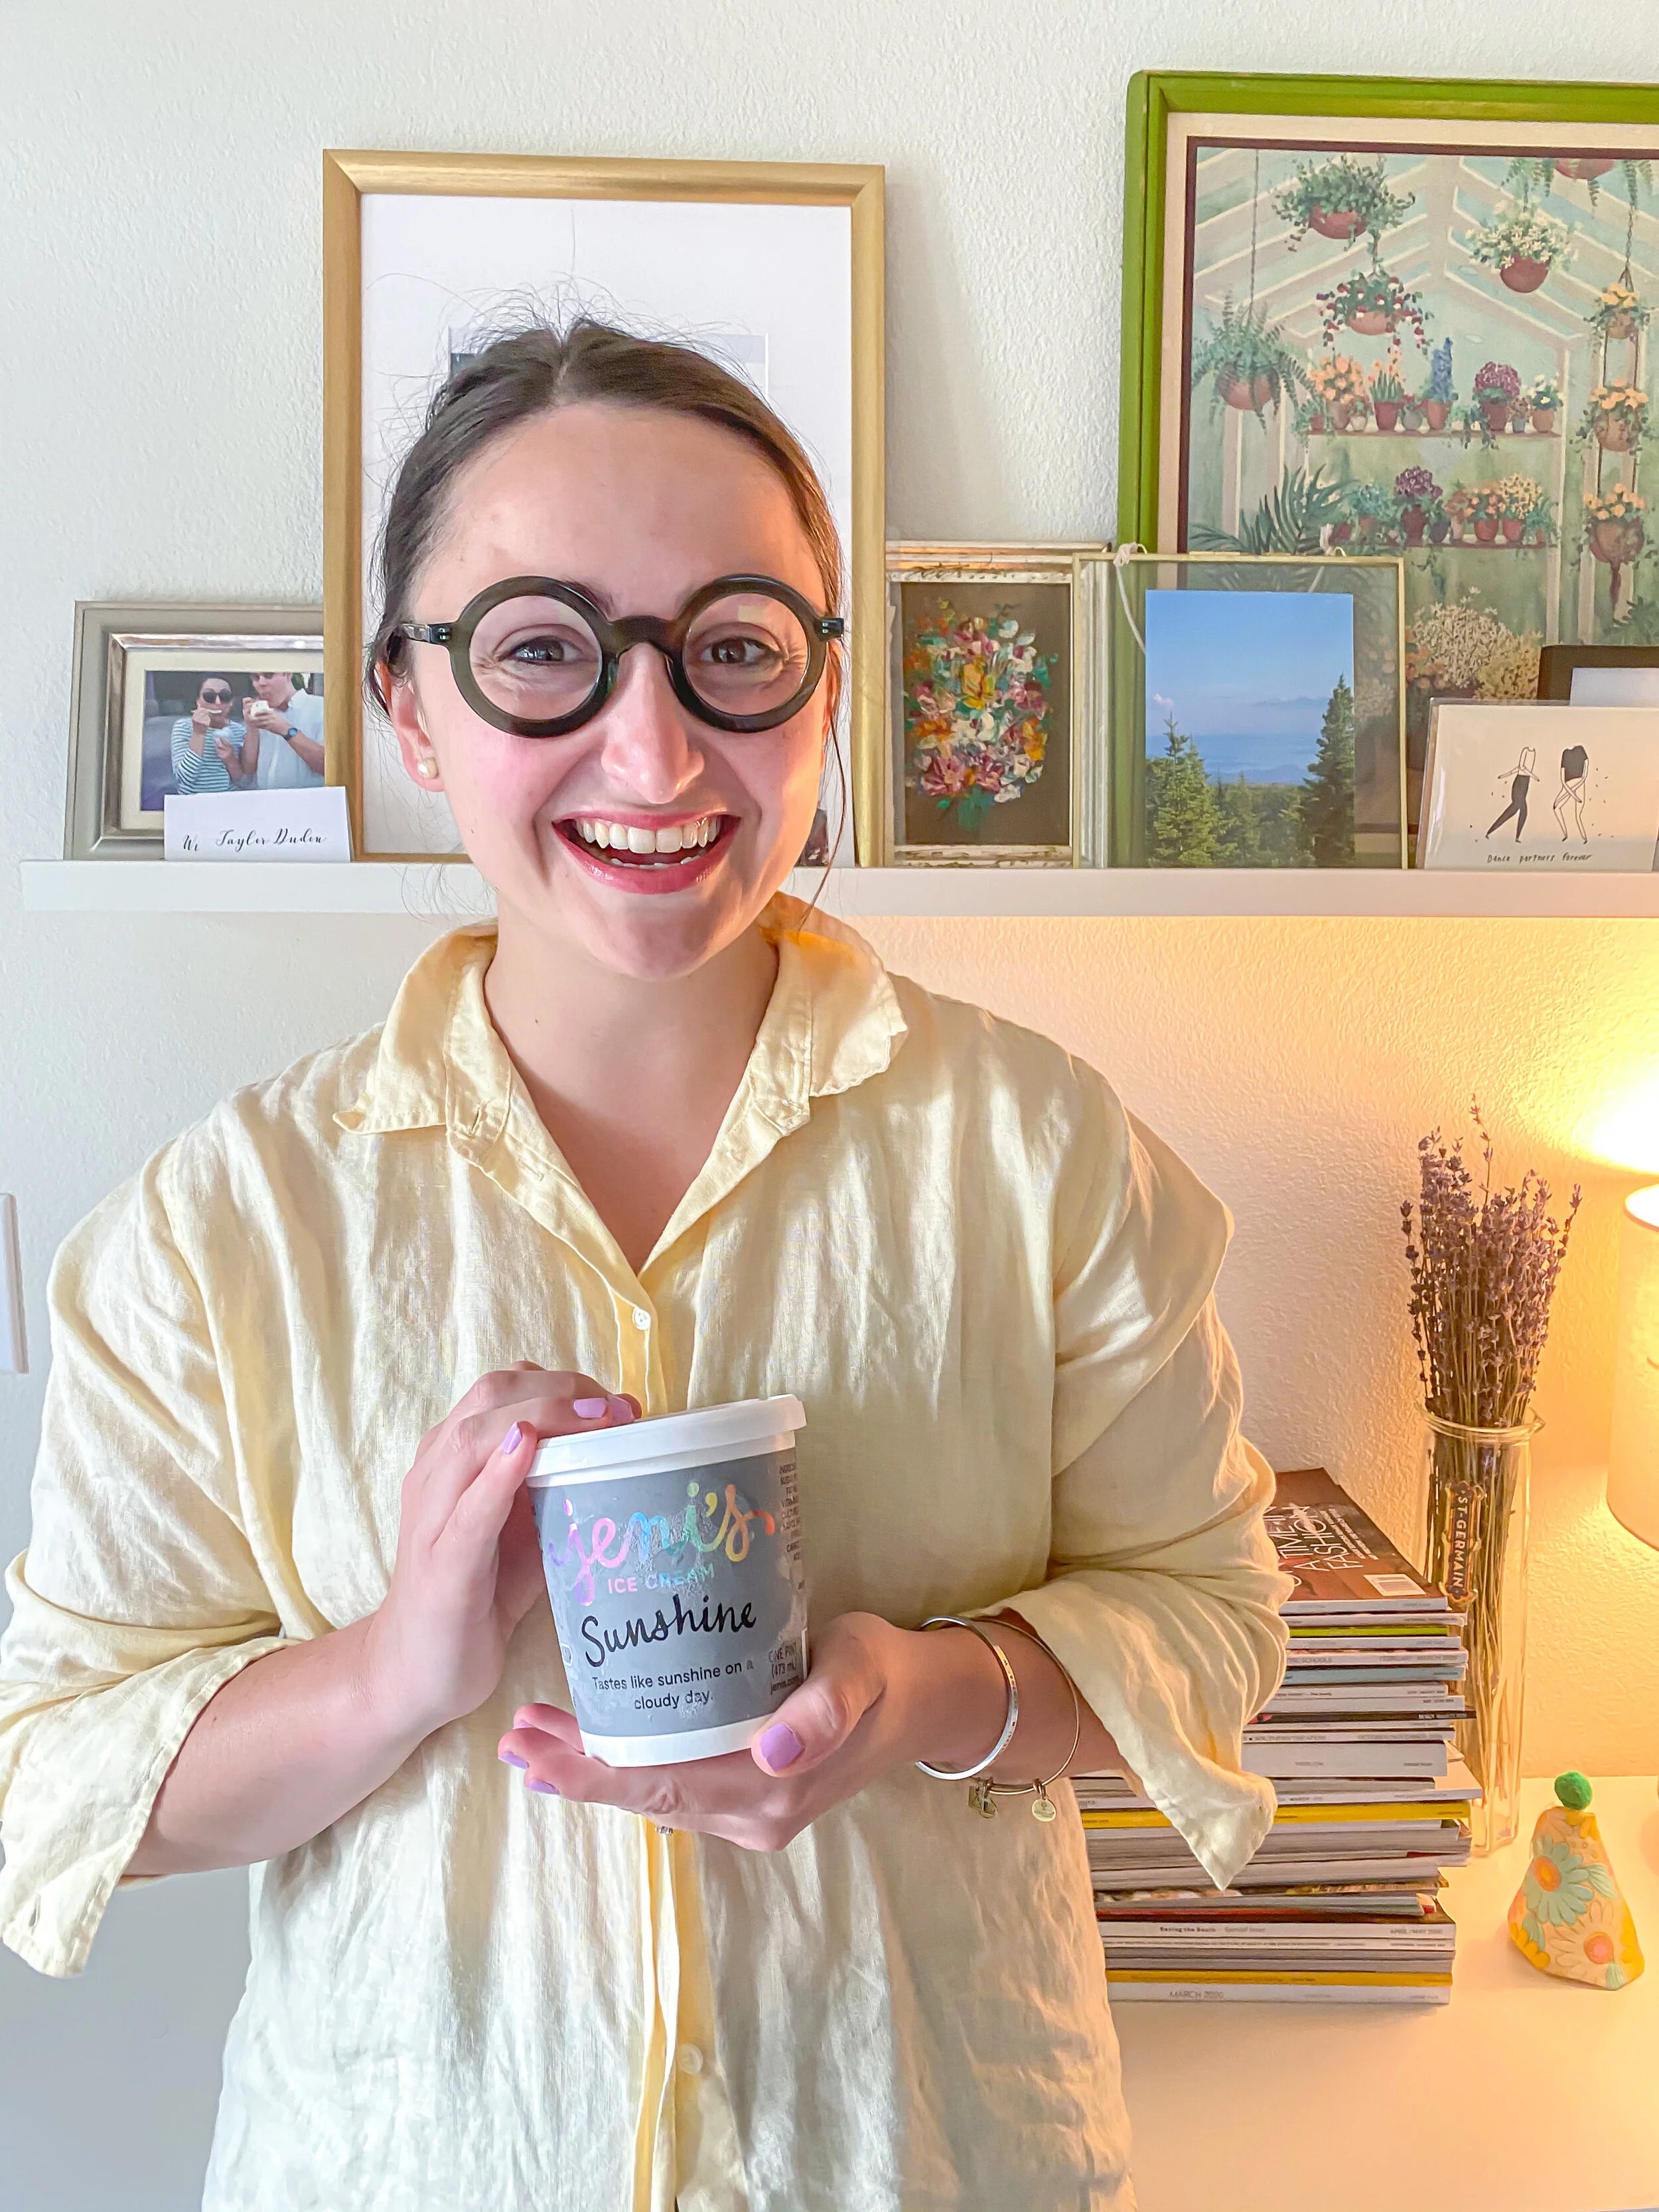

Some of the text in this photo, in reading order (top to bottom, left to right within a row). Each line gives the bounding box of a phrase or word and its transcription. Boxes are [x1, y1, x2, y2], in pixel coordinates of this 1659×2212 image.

[1487, 851, 1592, 865] Dance partners forever
[1282, 1506, 1364, 1570] FASHION
[608, 1562, 715, 1593] ICE CREAM
[1293, 1560, 1330, 1572] A
[581, 1593, 757, 1667] Sunshine
[593, 1660, 755, 1691] Tastes like sunshine on a
[634, 1690, 714, 1710] cloudy day.
